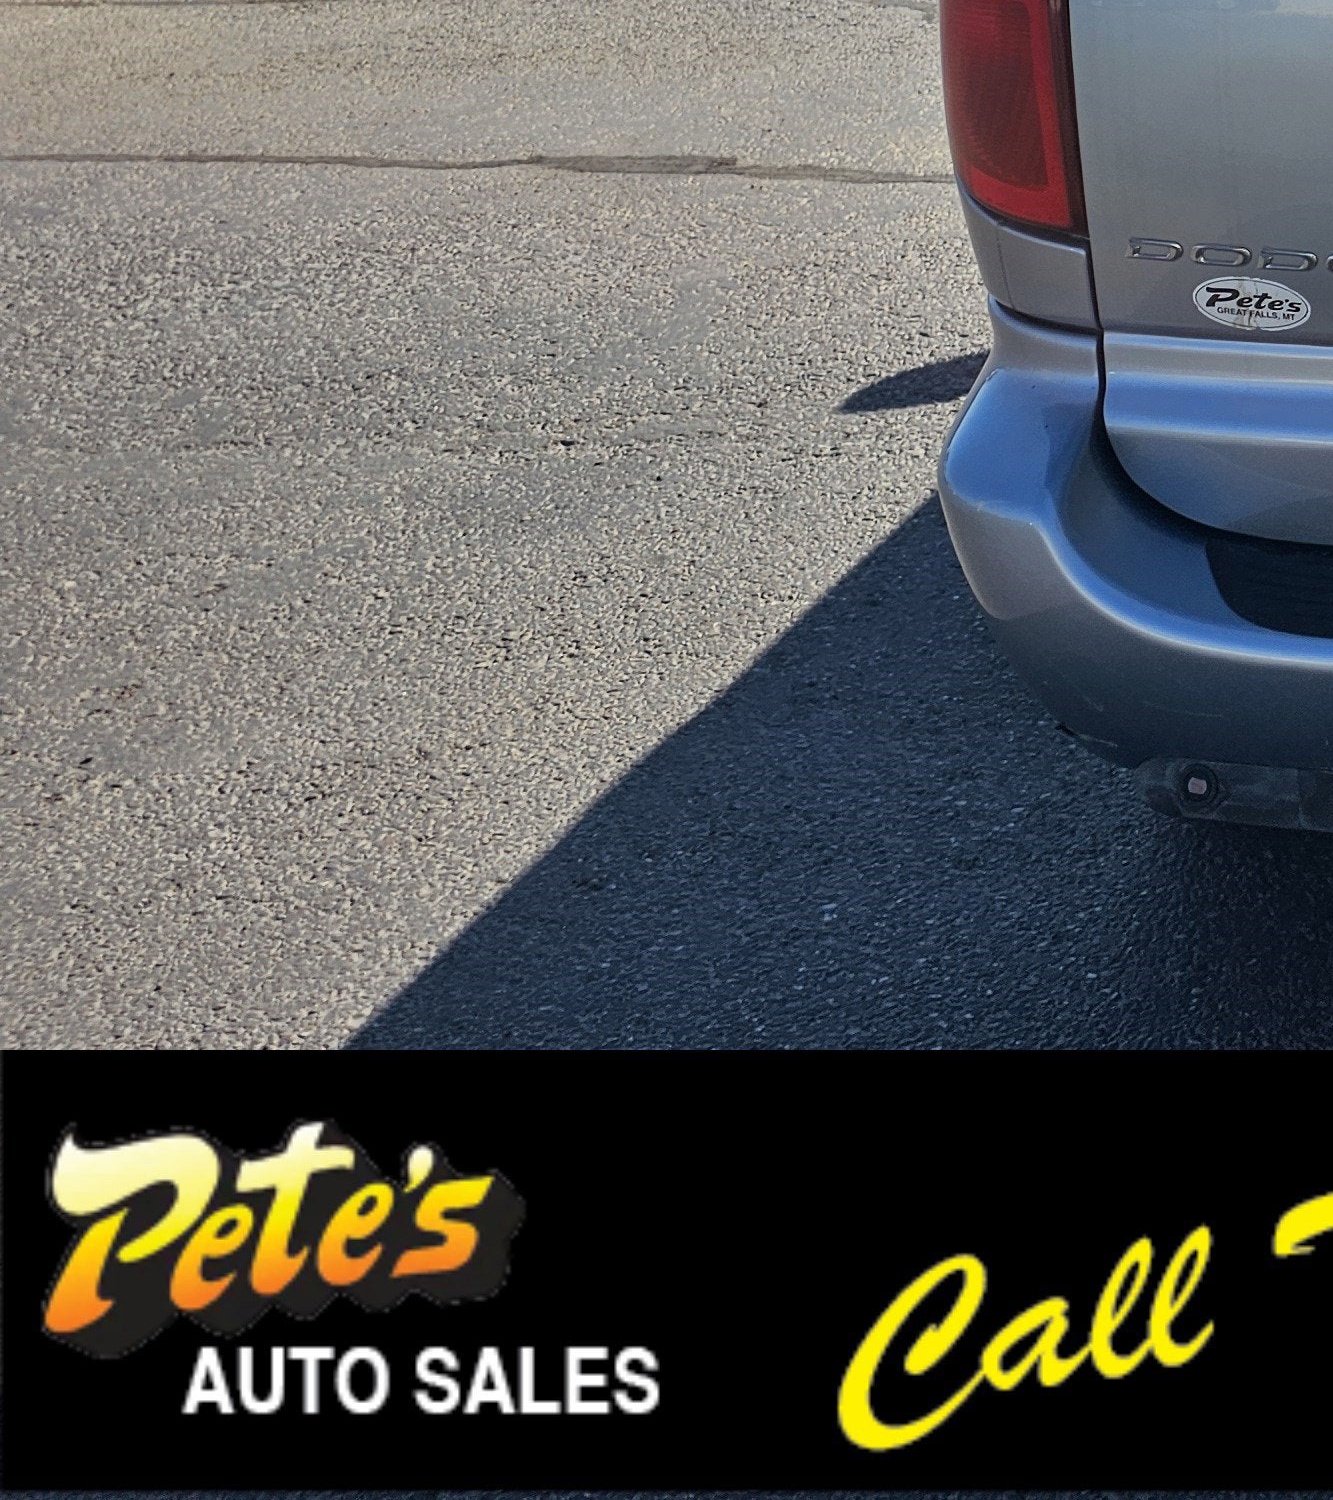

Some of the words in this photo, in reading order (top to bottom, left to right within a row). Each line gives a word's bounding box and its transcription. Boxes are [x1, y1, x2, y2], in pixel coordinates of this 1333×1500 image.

[1205, 286, 1302, 313] Pete's
[1217, 306, 1247, 317] GREAT
[1282, 312, 1296, 321] MT
